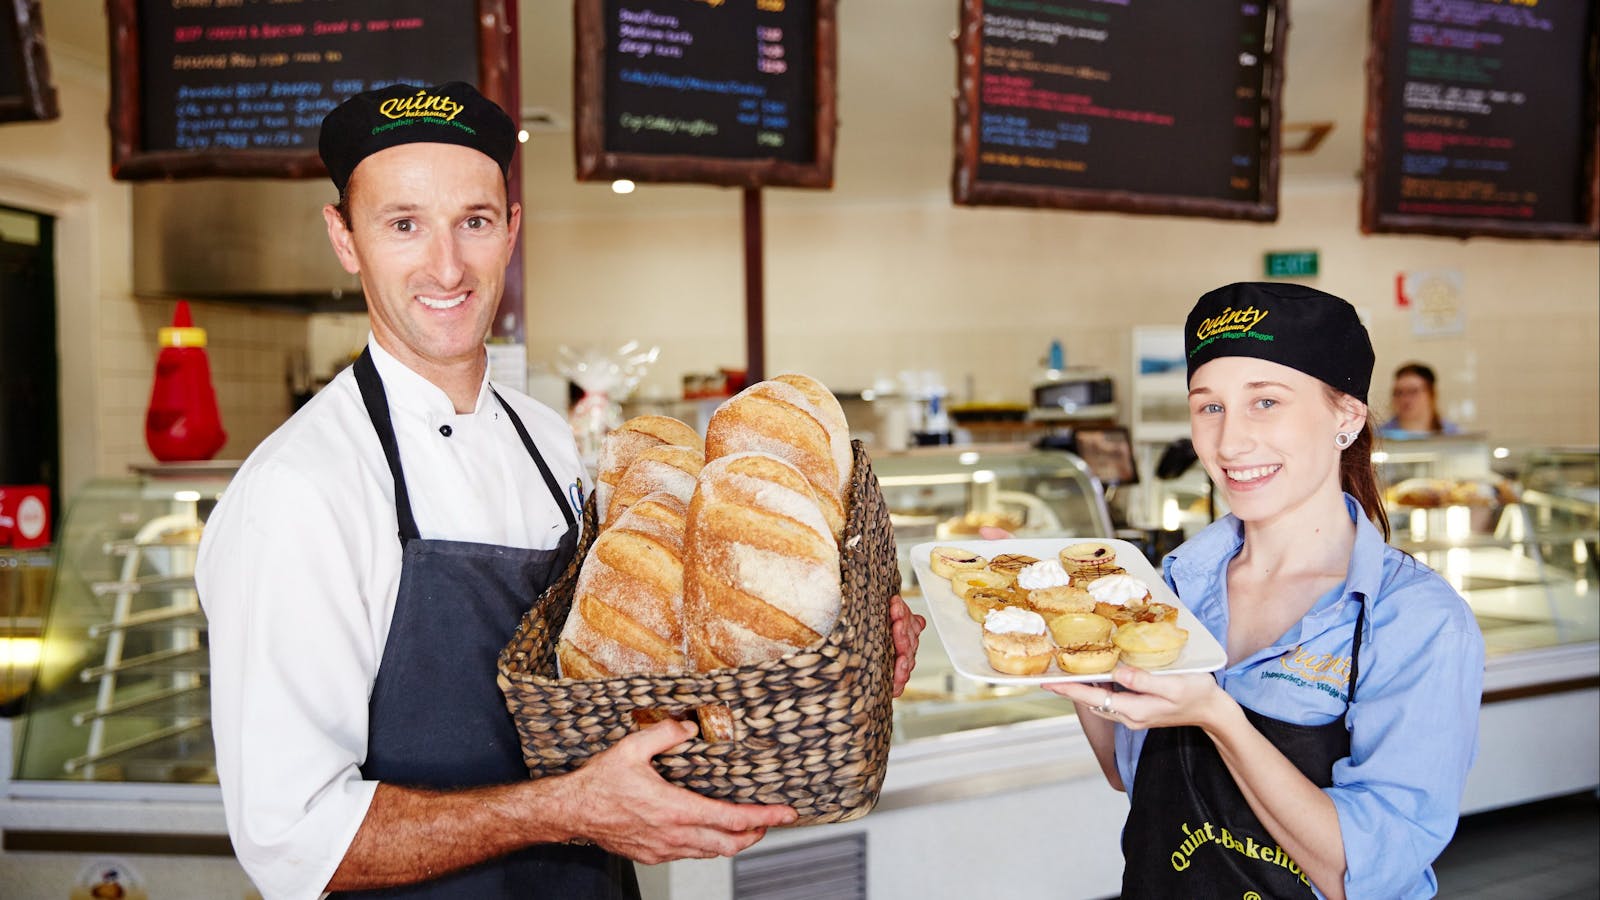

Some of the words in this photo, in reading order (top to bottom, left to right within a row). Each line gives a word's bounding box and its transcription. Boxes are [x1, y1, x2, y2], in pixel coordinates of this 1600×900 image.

[379, 90, 464, 121] Quinty
[1274, 254, 1313, 274] EXIT
[1196, 306, 1270, 340] Quinty
